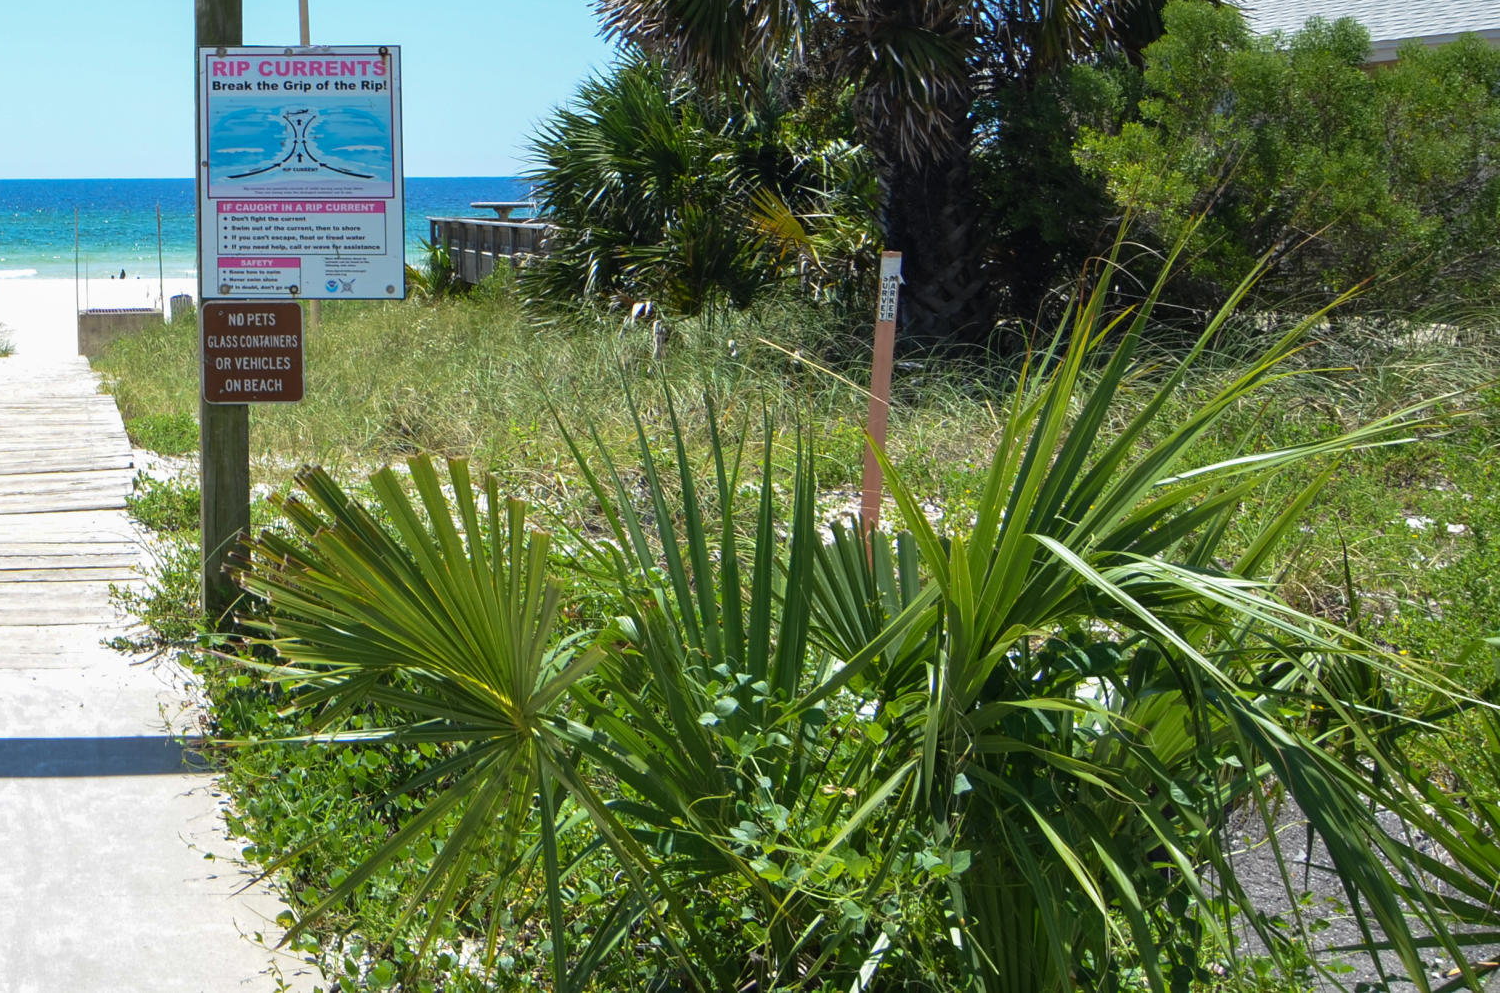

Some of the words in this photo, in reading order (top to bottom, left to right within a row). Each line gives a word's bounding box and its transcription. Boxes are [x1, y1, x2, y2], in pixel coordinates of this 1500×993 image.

[212, 60, 251, 77] RIP
[258, 60, 387, 77] CURRENTS
[212, 80, 252, 91] Break
[257, 80, 279, 91] the
[283, 80, 312, 93] Grip
[315, 80, 330, 91] of
[334, 80, 356, 91] the
[361, 80, 387, 93] Rip!
[222, 203, 232, 211] IF
[235, 203, 278, 212] CAUGHT
[281, 203, 293, 212] IN
[295, 203, 303, 212] A
[305, 203, 323, 212] RIP
[325, 203, 375, 212] CURRENT
[240, 259, 274, 267] SAFETY
[228, 313, 245, 326] NO
[247, 313, 276, 326] PETS
[207, 335, 238, 348] GLASS
[239, 335, 298, 348] CONTAINERS
[215, 357, 232, 370] OR
[235, 357, 291, 370] VEHICLES
[225, 379, 242, 392] ON
[244, 379, 282, 392] BEACH
